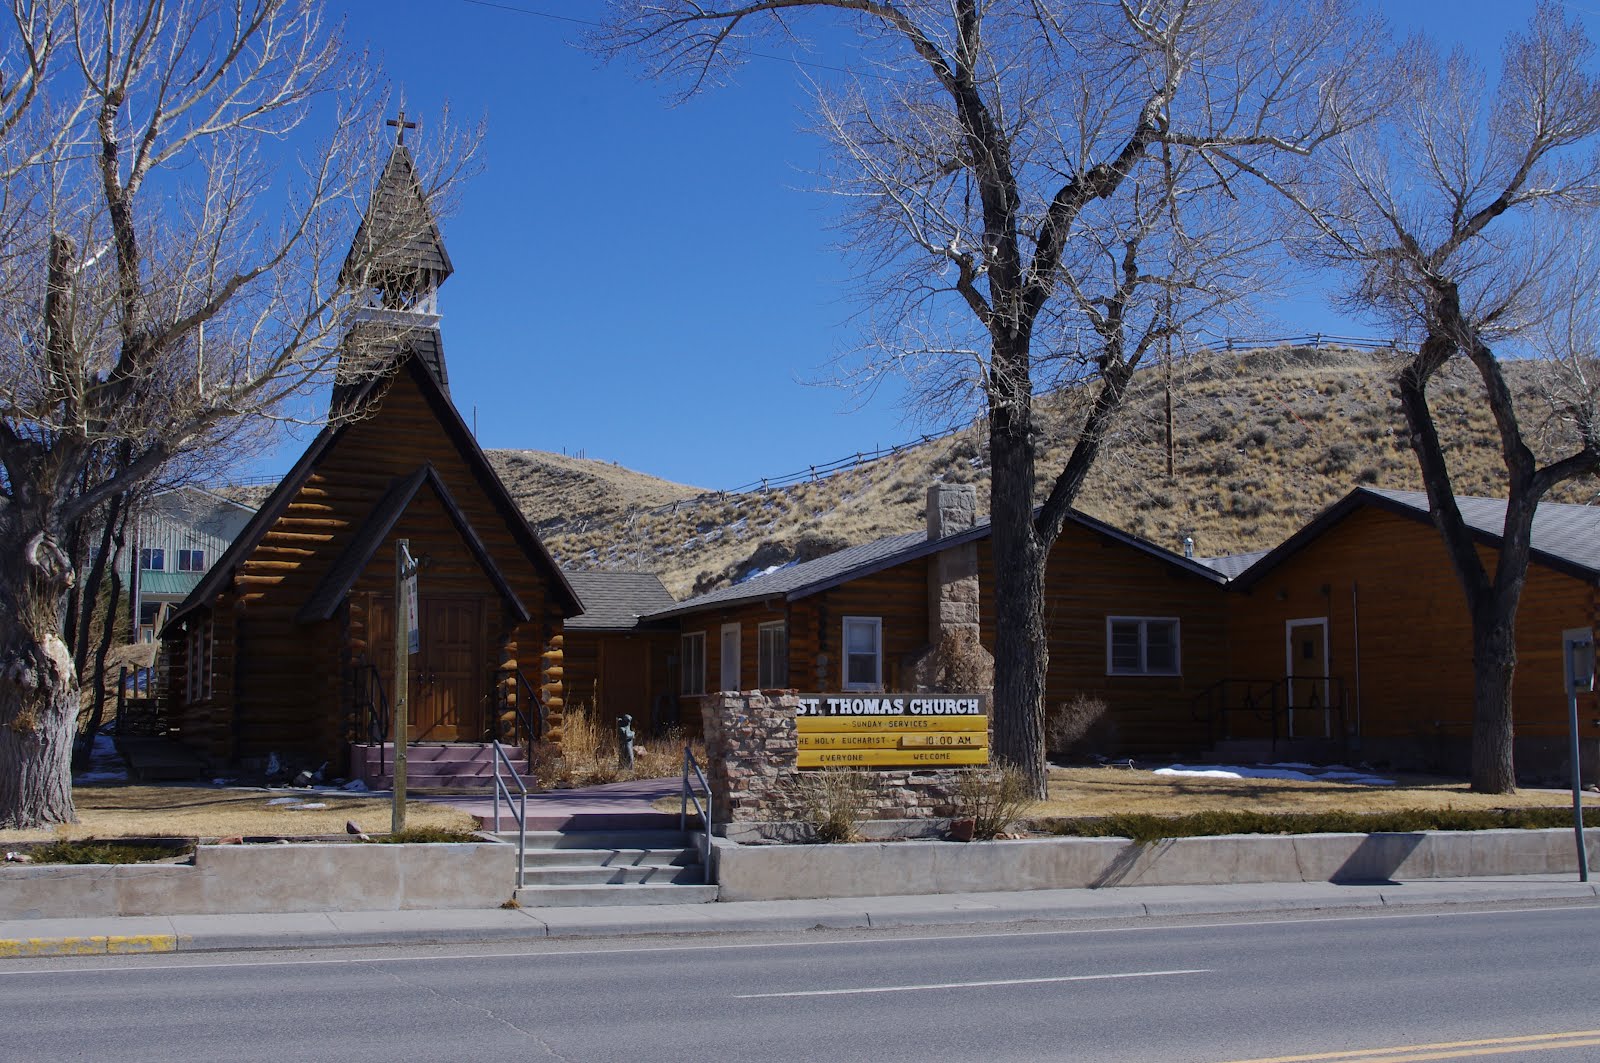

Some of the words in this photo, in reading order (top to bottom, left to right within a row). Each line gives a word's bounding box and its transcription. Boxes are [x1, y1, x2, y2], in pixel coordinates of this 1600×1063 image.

[796, 698, 823, 715] ST.
[827, 698, 904, 715] THOMAS
[909, 698, 979, 715] CHURCH
[851, 720, 882, 728] SUNDAY
[888, 720, 928, 728] SERVICES
[799, 737, 809, 745] HE
[814, 737, 836, 745] HOLY
[841, 736, 886, 744] EUCHARIST
[925, 736, 953, 745] 10:00
[957, 736, 972, 745] AM
[820, 754, 863, 762] EVERYONE
